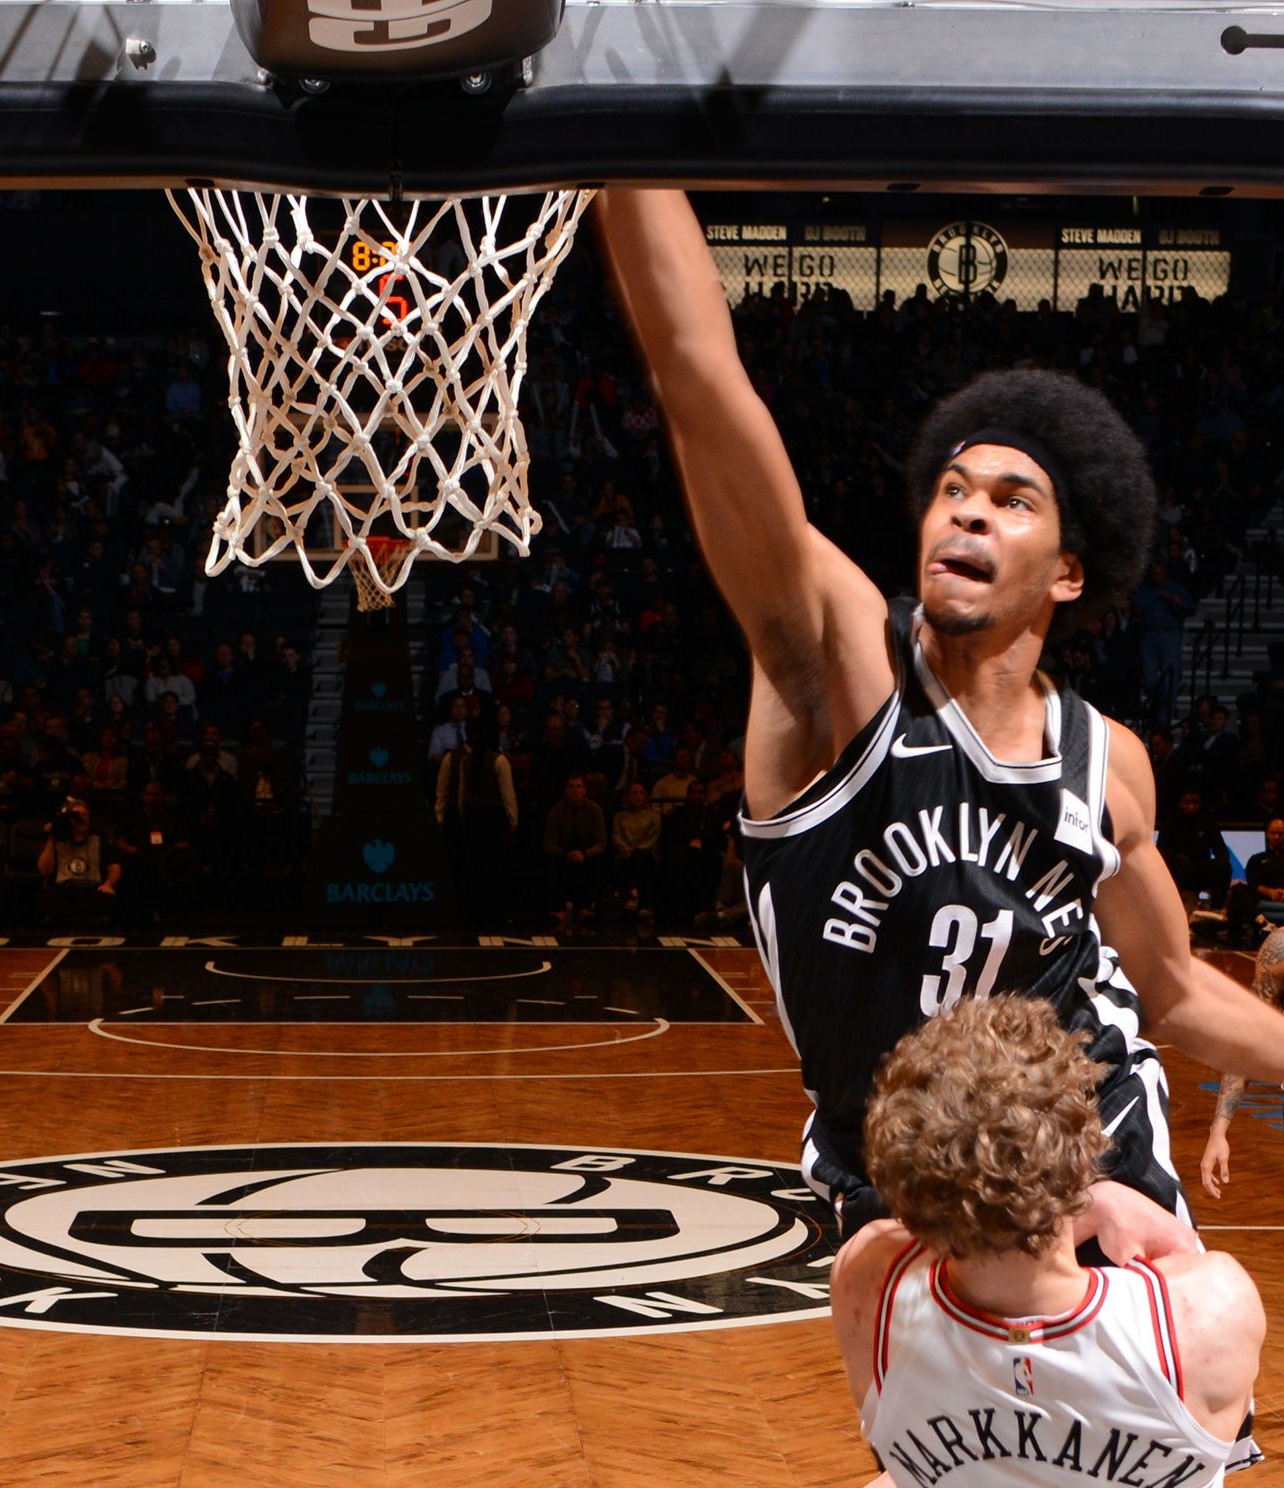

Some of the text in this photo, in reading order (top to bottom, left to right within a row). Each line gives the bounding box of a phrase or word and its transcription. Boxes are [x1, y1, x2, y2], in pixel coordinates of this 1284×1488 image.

[706, 224, 788, 241] STEVE MADDEN
[1060, 227, 1143, 244] STEVE MADDEN
[744, 254, 786, 278] WE
[1098, 257, 1141, 281] WE
[822, 802, 1039, 955] BROOKLYN
[324, 881, 437, 904] BARCLAYS
[919, 903, 1015, 1018] 31
